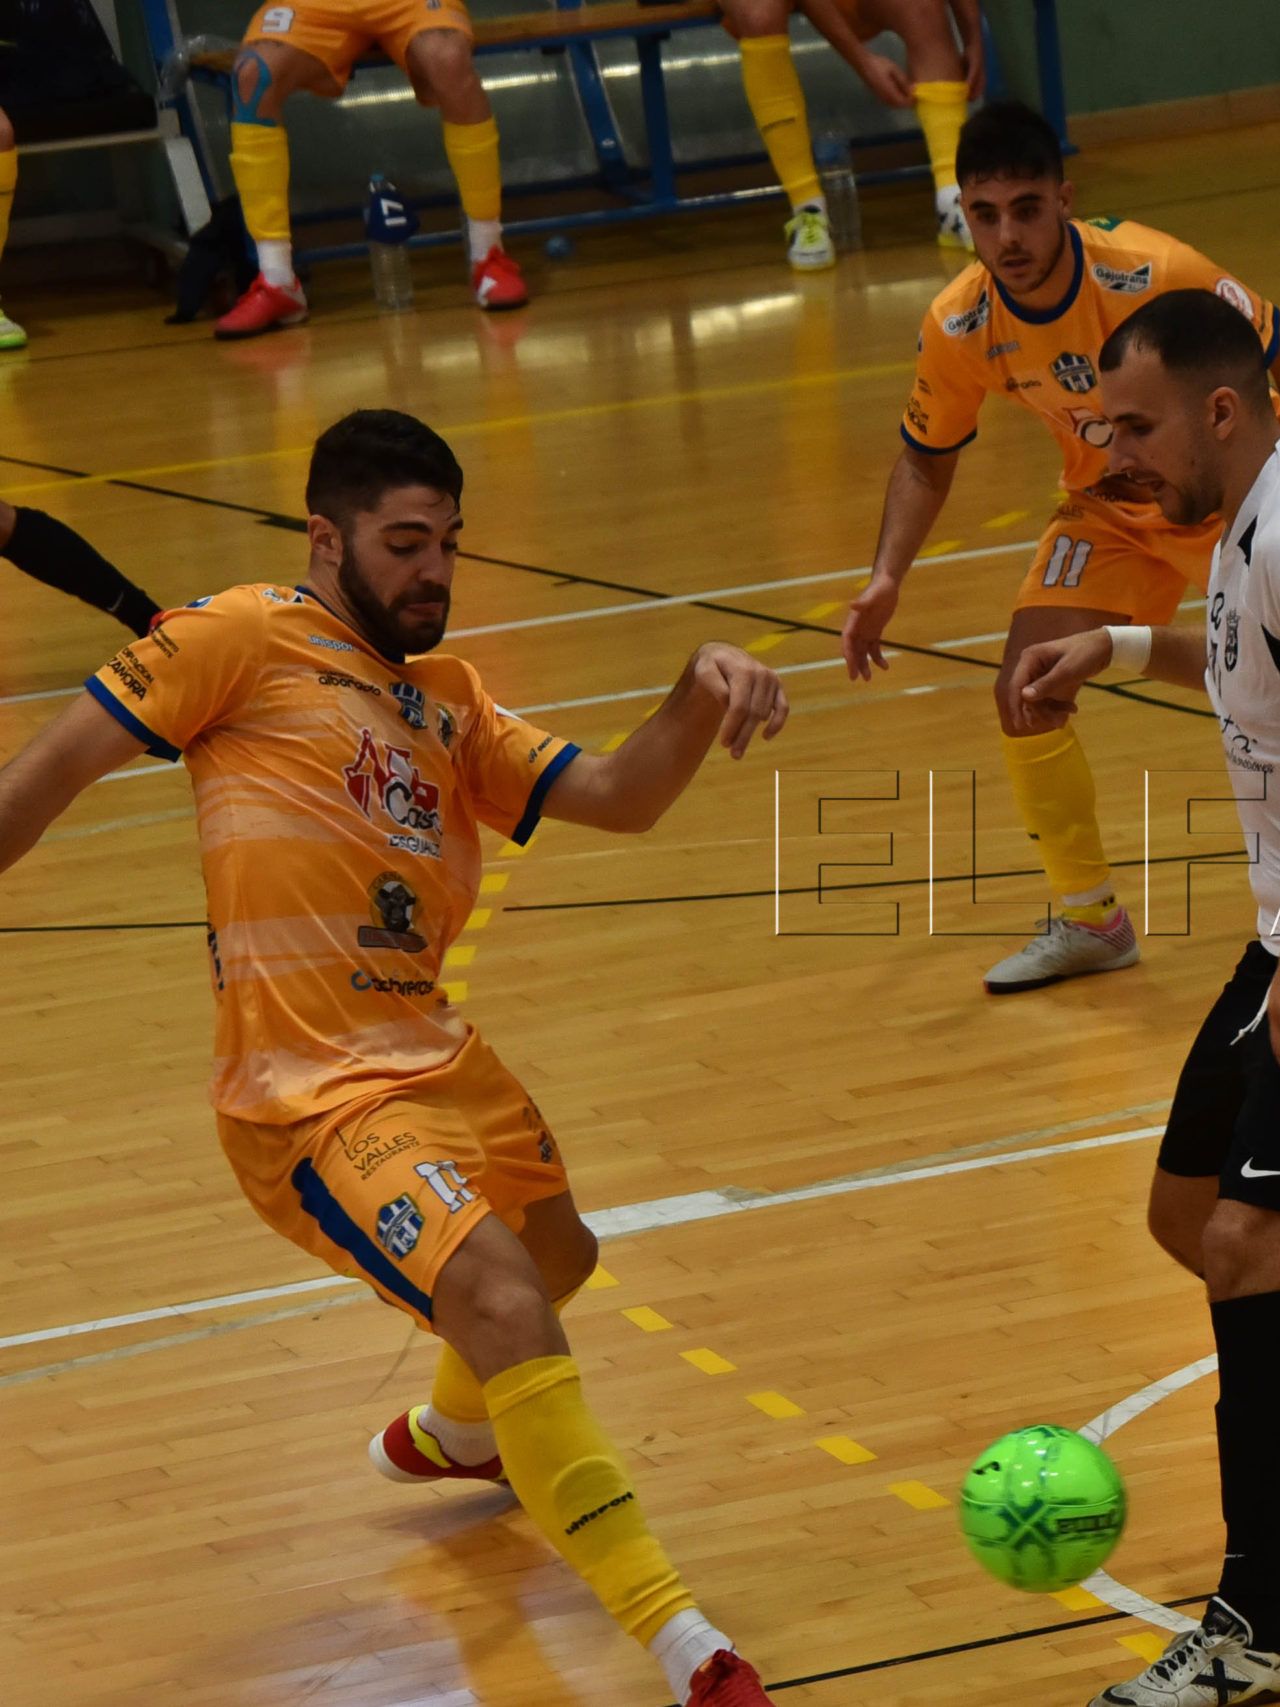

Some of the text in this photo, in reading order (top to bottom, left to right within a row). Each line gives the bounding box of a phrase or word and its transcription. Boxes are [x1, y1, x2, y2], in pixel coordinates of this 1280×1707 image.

[1041, 533, 1093, 588] 11
[354, 1131, 418, 1172] VALLES
[361, 1140, 421, 1181] RESTAURANTE
